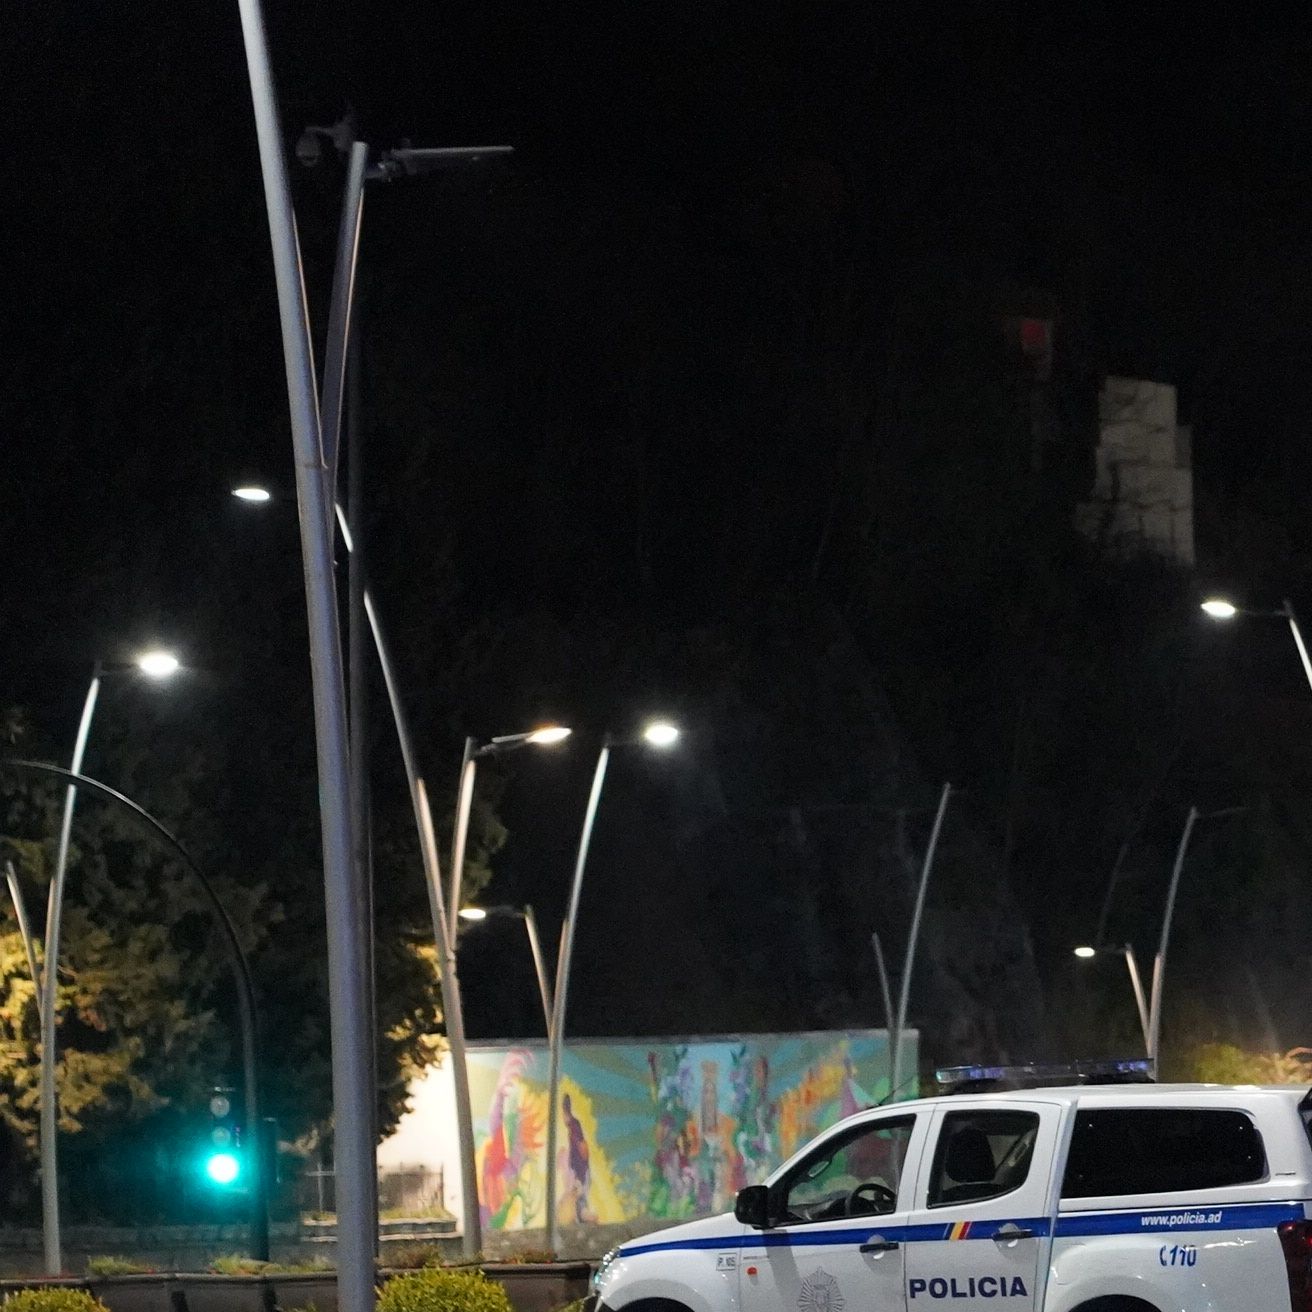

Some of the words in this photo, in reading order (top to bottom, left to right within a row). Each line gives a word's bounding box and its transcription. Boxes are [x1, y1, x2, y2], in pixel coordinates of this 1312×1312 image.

[1141, 1210, 1222, 1227] www.policia.ad
[1169, 1244, 1197, 1267] 110
[909, 1276, 1028, 1299] POLICIA
